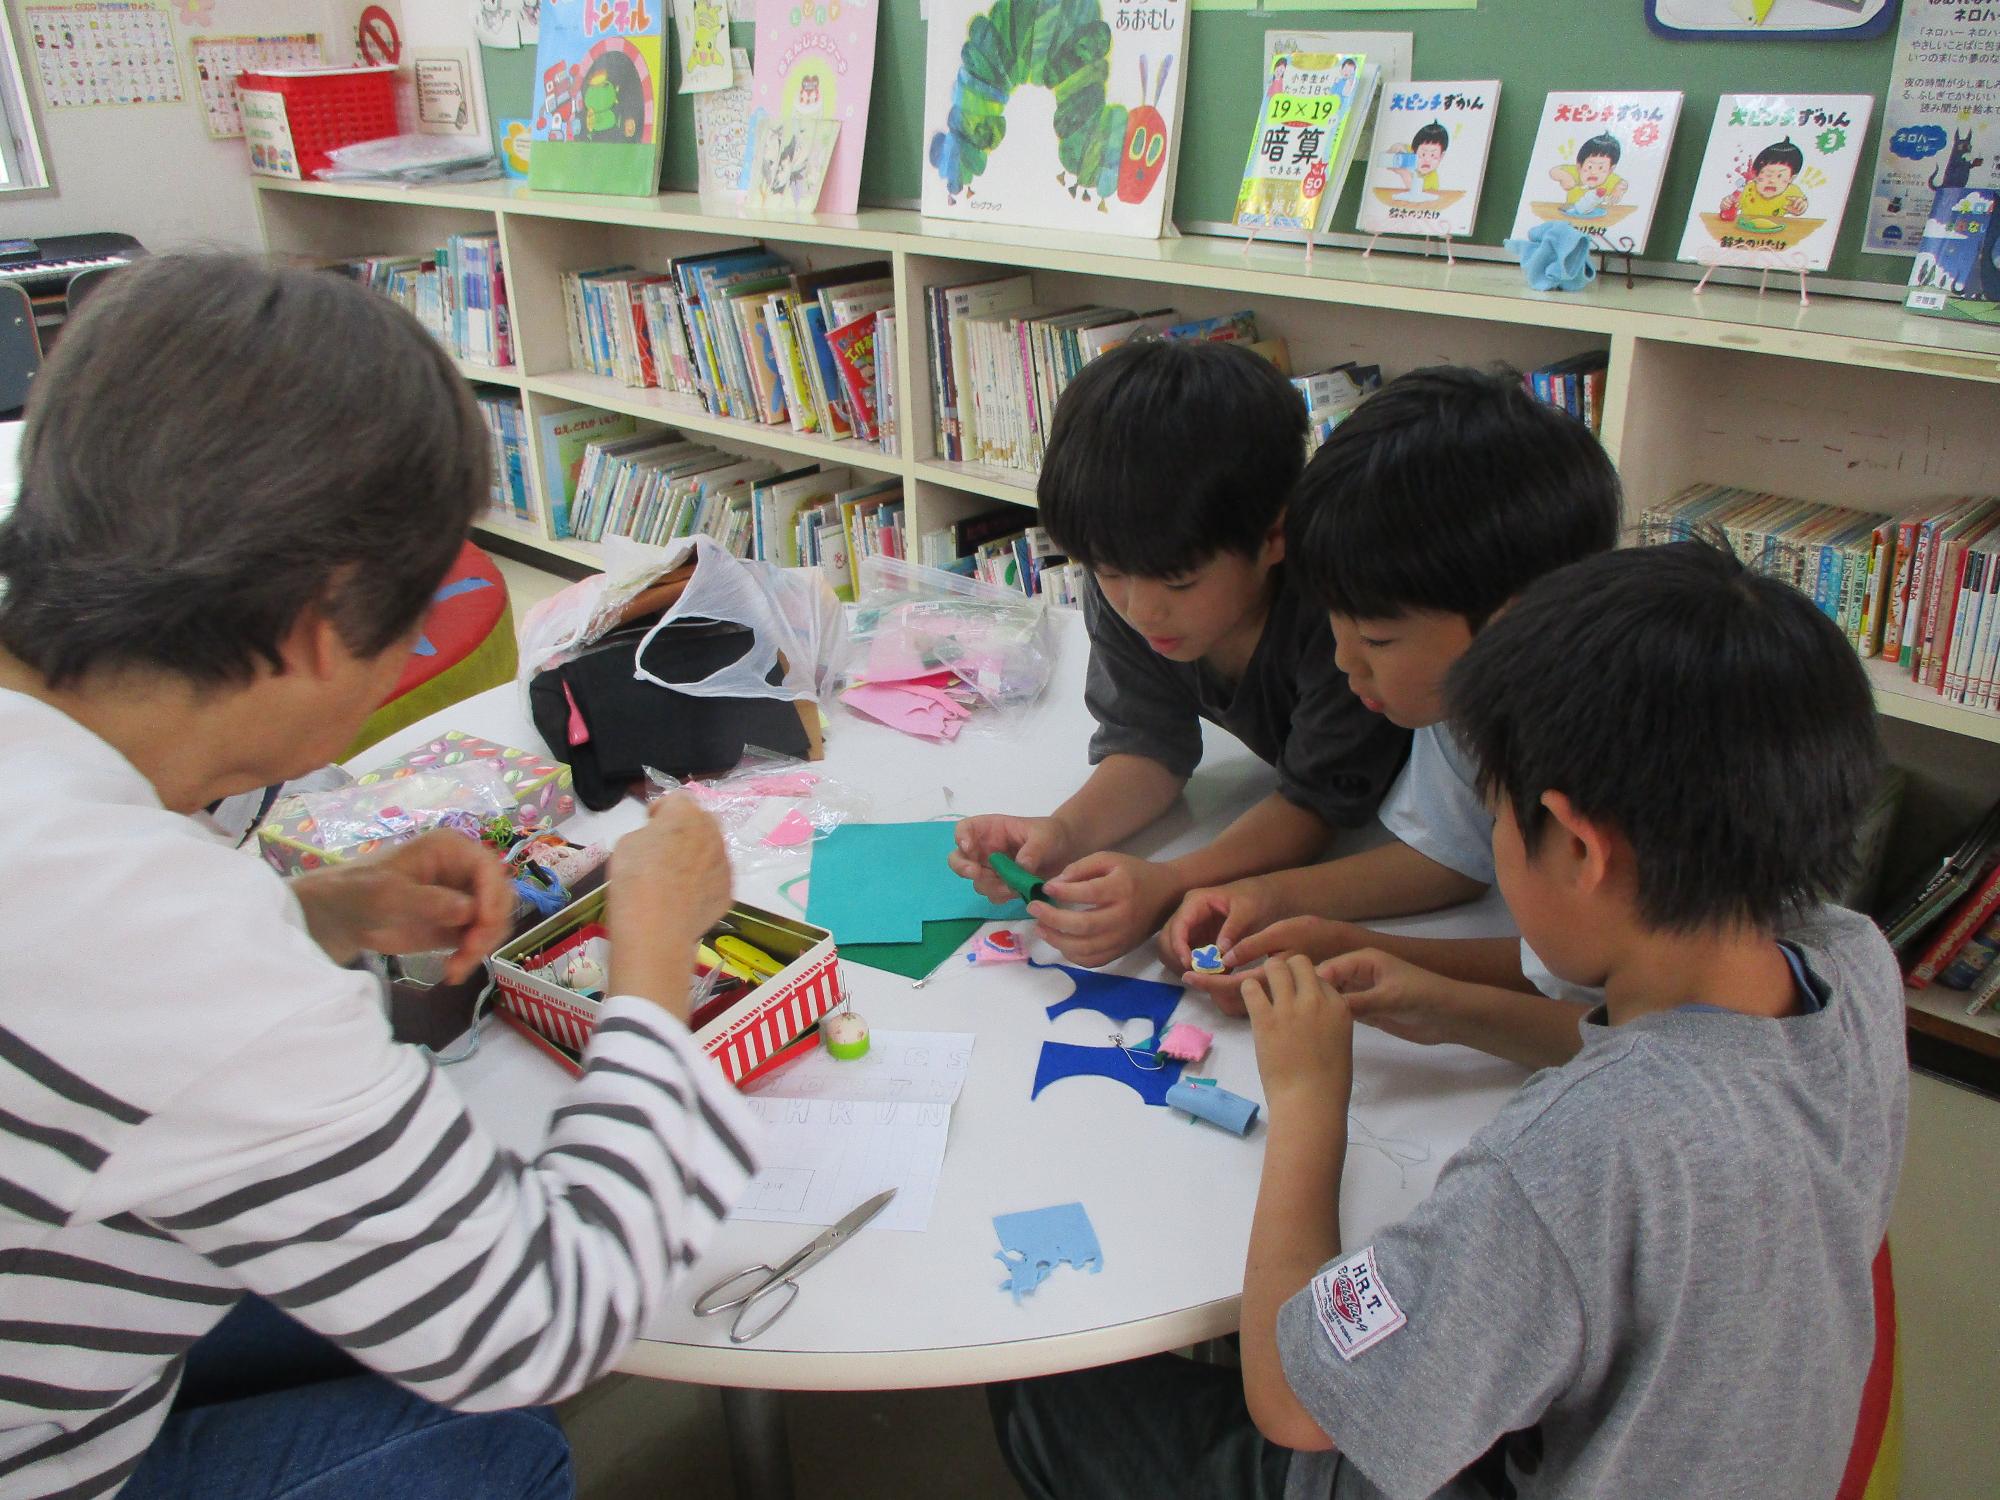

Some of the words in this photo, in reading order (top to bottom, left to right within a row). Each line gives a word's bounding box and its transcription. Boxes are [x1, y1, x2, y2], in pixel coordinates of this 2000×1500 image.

[584, 0, 651, 36] トンネル
[1116, 8, 1175, 31] あおむし
[1292, 74, 1329, 84] 小学生が
[1285, 85, 1330, 96] たった1日で
[1390, 92, 1484, 112] 大ピンチずかん
[1554, 103, 1664, 122] 大ピンチずかん
[1728, 105, 1850, 127] 大ピンチずかん
[1639, 127, 1651, 142] 2
[1824, 133, 1838, 149] 3
[1897, 133, 1938, 144] ネロハー
[1261, 126, 1324, 165] 暗算
[1269, 166, 1302, 176] できる本
[1305, 178, 1323, 190] 50
[1388, 207, 1440, 220] 鈴木のりたけ
[1720, 235, 1787, 250] 鈴木のりたけ
